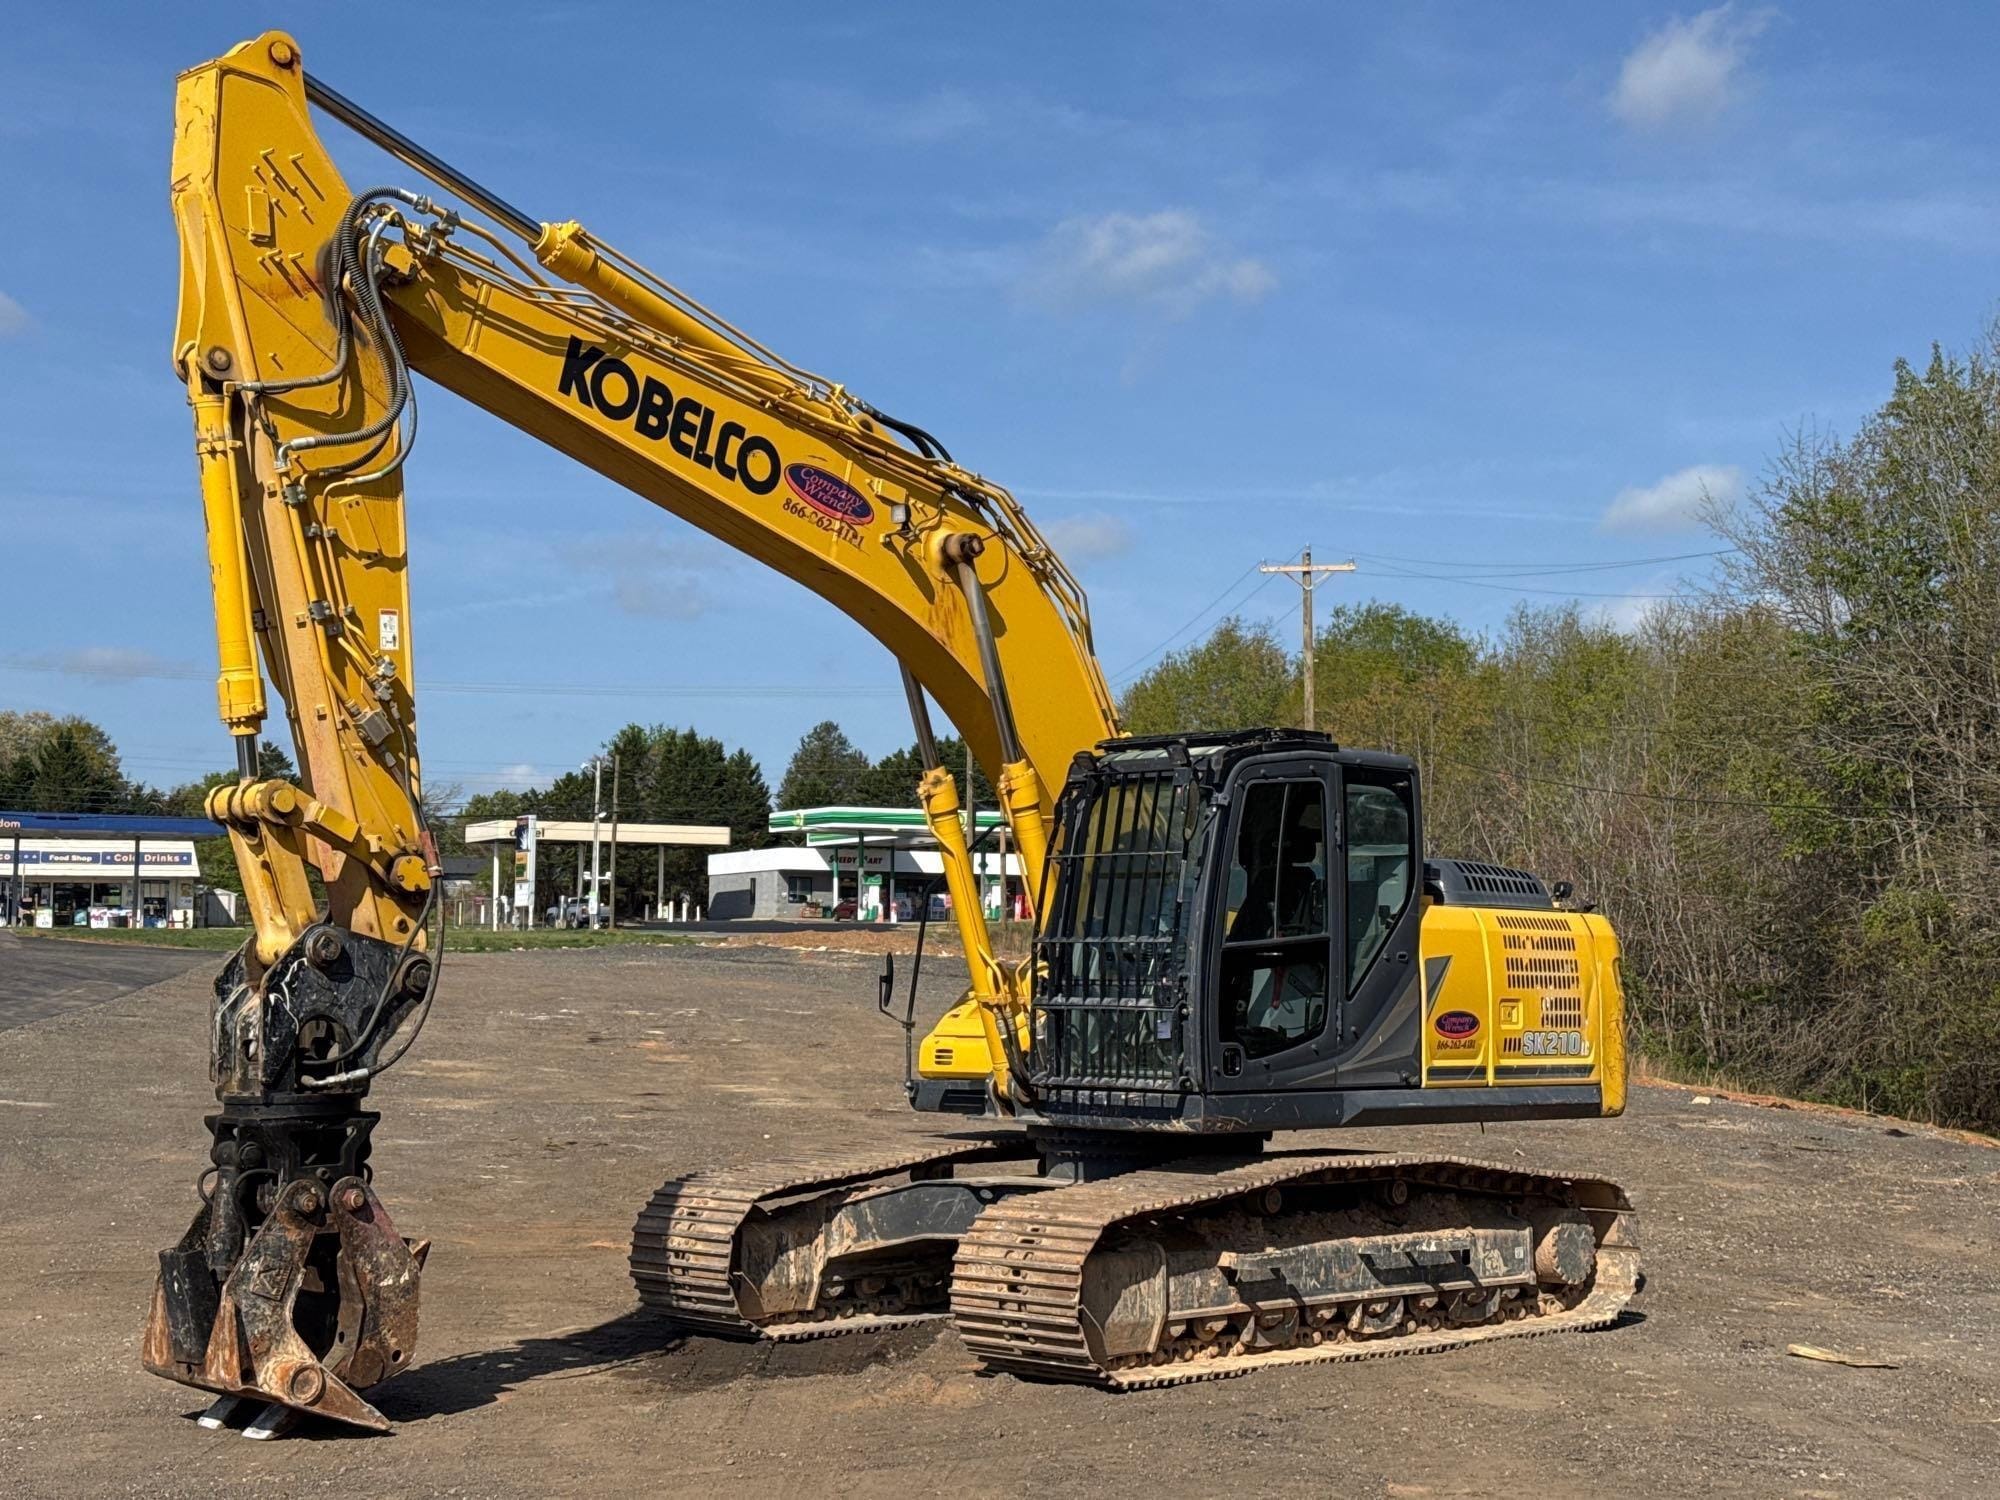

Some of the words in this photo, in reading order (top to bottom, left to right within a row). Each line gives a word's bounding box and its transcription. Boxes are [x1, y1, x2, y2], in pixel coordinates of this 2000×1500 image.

[558, 334, 781, 495] KOBELCO
[800, 467, 863, 507] Company
[803, 480, 853, 515] Wrench
[144, 854, 180, 862] Drinks
[829, 855, 857, 863] SEEDY
